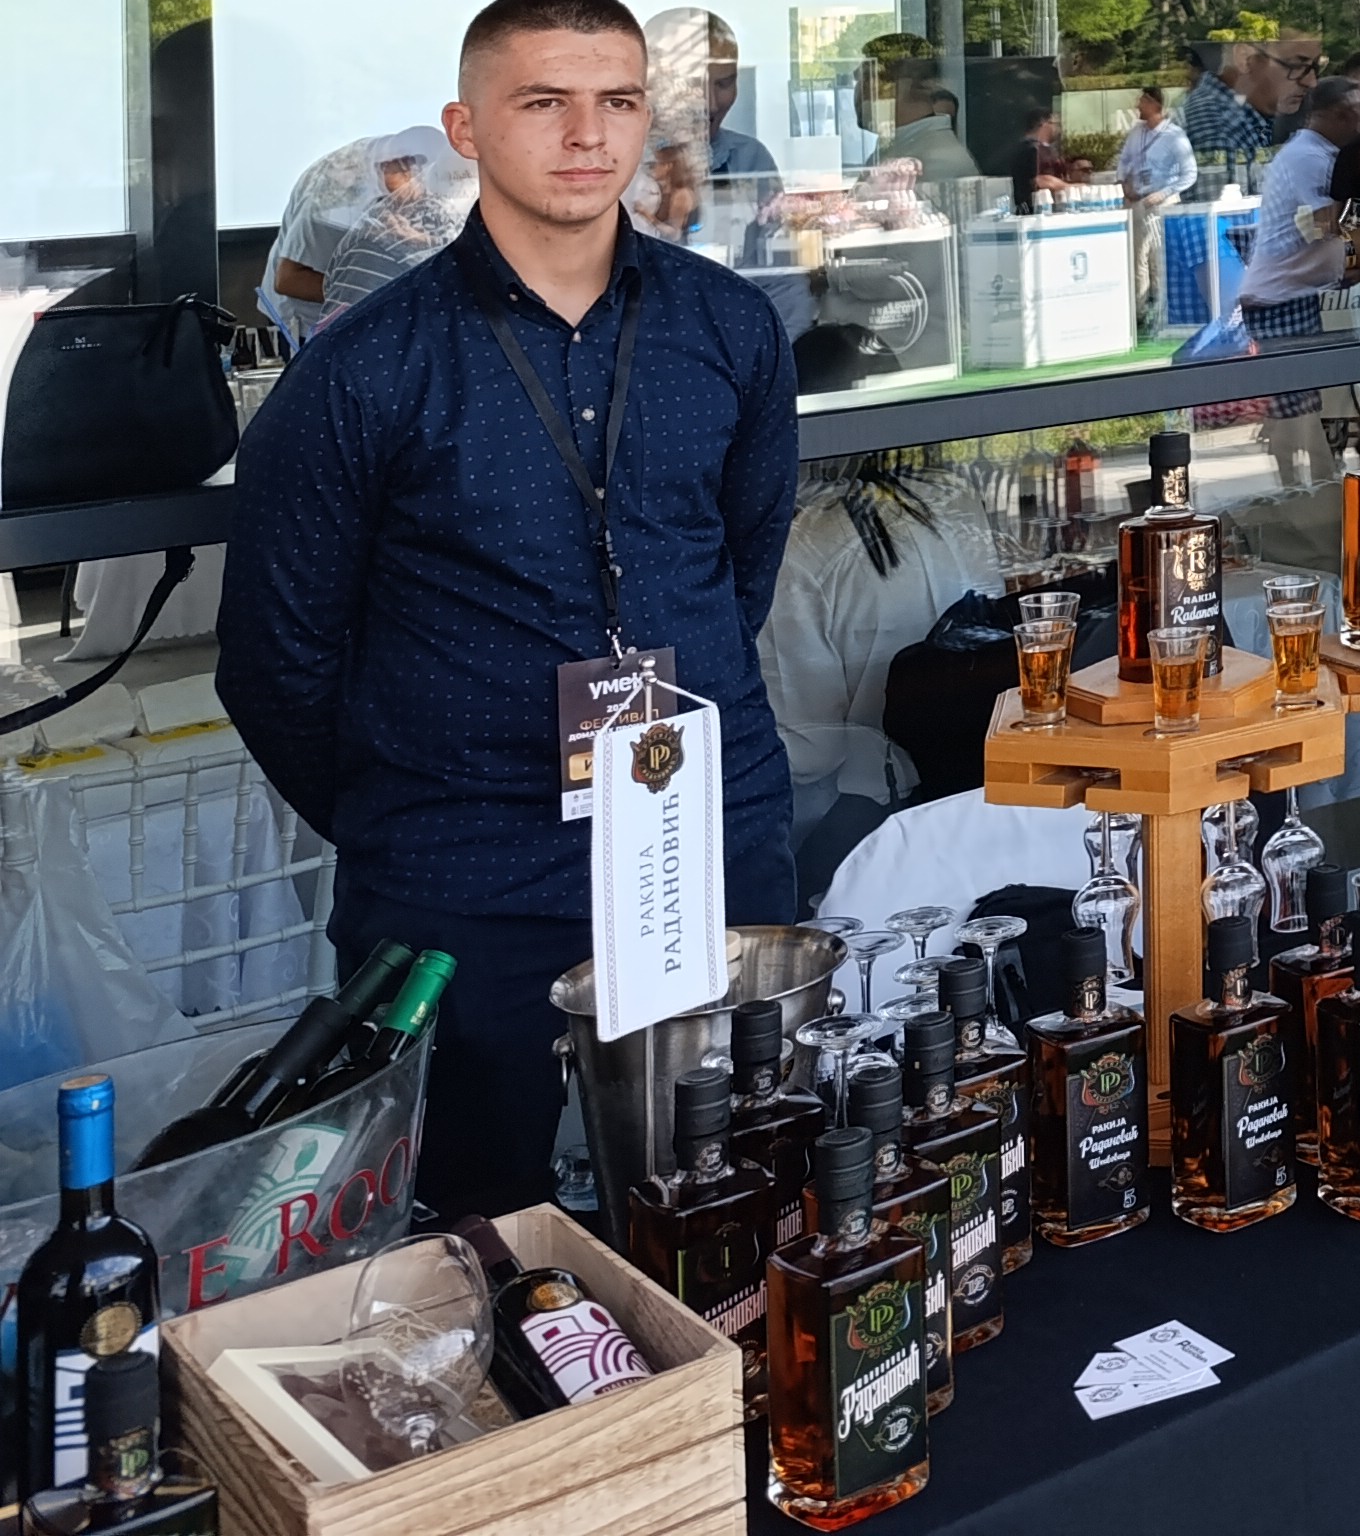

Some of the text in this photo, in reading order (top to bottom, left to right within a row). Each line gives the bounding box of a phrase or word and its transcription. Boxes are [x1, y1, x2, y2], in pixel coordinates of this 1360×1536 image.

[1183, 591, 1217, 605] RAKIJA
[1170, 600, 1220, 625] Radanović
[639, 843, 655, 938] РАКИЈА
[662, 792, 684, 975] РАДАНОВИЋ
[1248, 1096, 1279, 1114] РАКИЈА
[1091, 1117, 1127, 1134] РАКИЈА
[1275, 1166, 1287, 1186] 5
[276, 1136, 413, 1277] ROO
[1123, 1188, 1137, 1209] 5
[953, 1206, 997, 1271] ановић
[886, 1417, 909, 1442] 12
